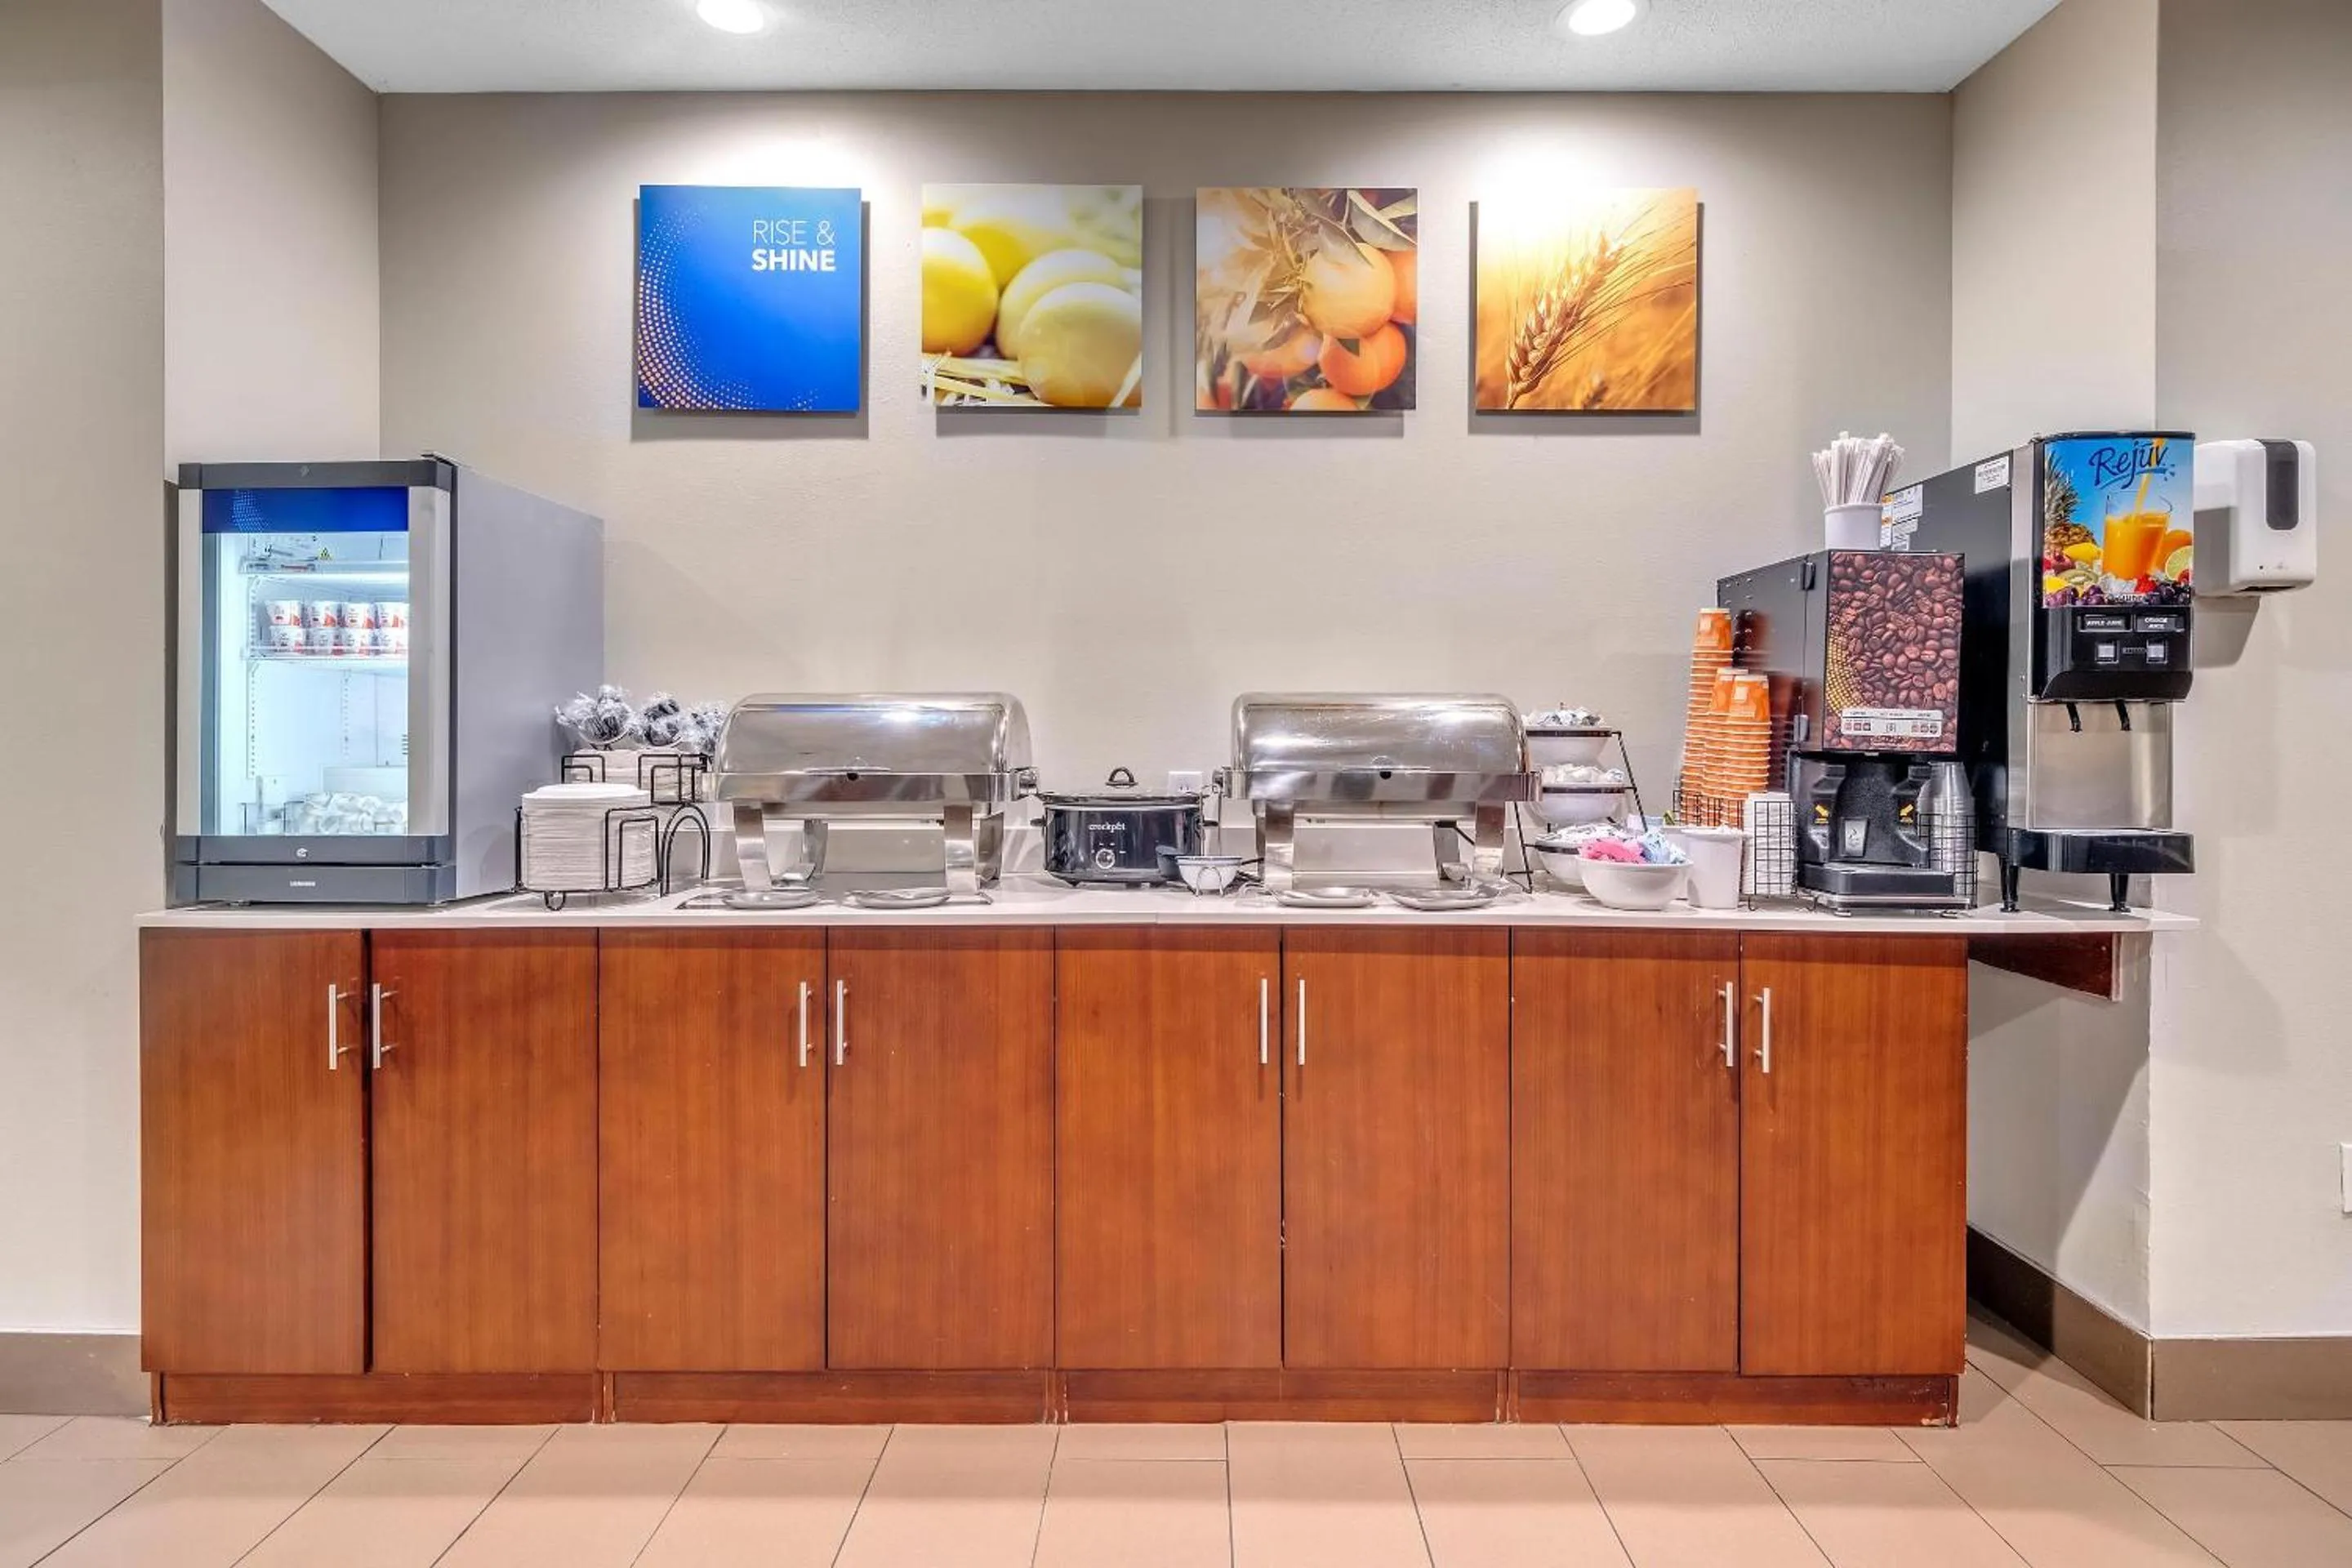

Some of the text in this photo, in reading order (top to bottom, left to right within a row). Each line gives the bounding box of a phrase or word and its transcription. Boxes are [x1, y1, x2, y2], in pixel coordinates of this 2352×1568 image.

[753, 220, 835, 245] RISE &
[751, 248, 836, 271] SHINE
